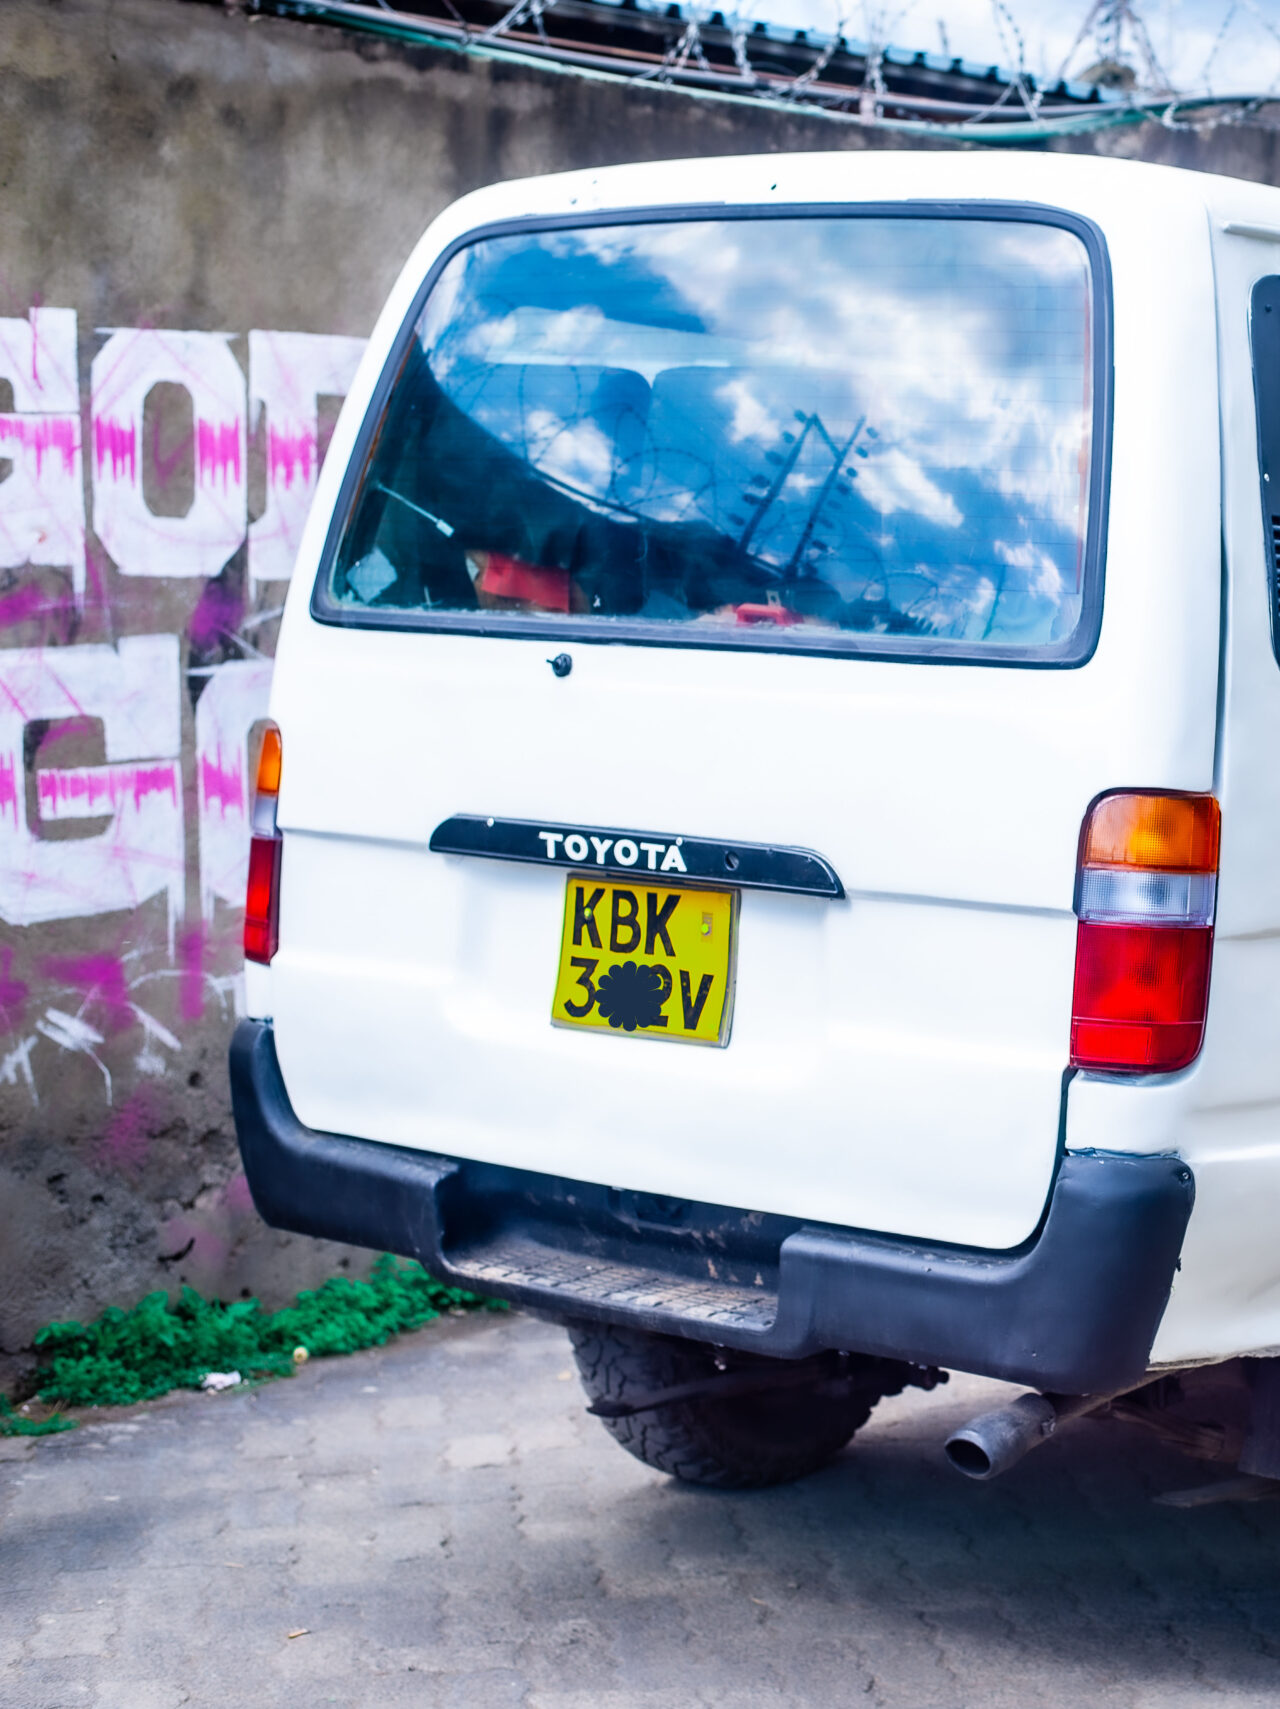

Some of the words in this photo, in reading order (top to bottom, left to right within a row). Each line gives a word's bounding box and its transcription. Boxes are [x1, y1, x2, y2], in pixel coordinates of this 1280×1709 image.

[538, 831, 688, 872] TOYOTA
[572, 886, 682, 957] KBK
[563, 956, 715, 1031] 32V
